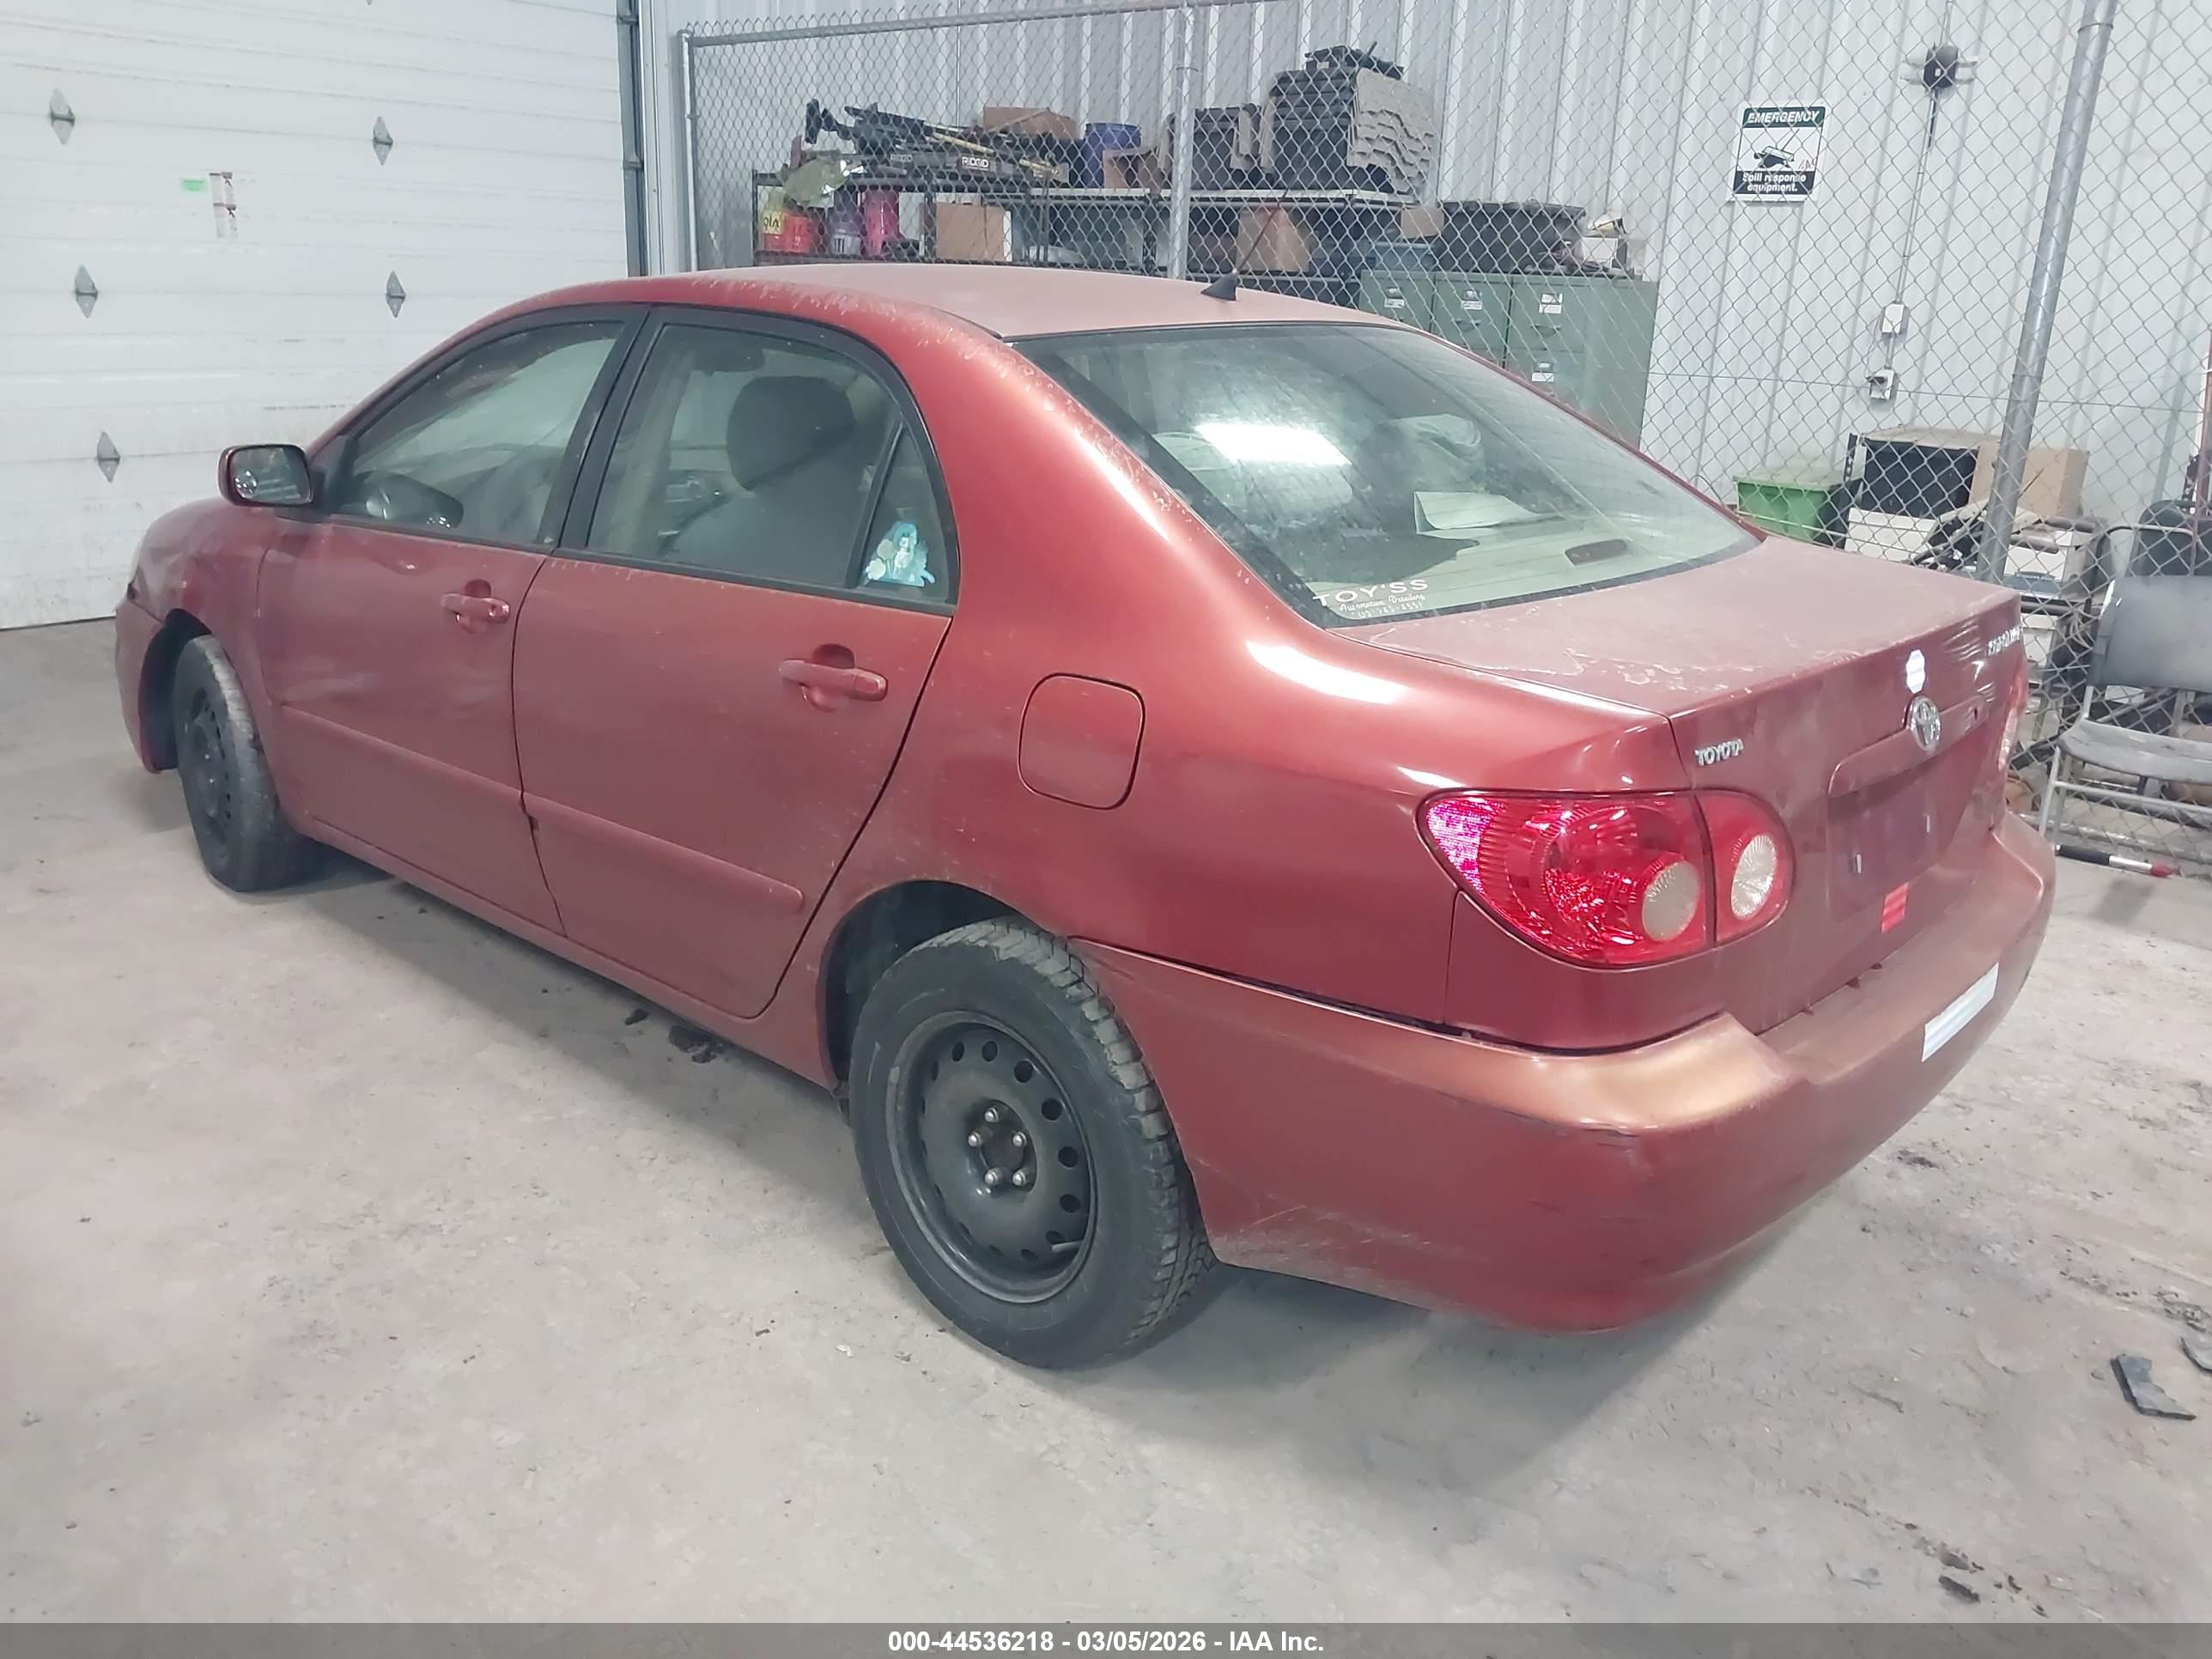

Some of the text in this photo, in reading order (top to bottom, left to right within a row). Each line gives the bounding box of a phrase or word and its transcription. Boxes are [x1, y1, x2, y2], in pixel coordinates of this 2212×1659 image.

[1747, 111, 1820, 124] EMERGENCY
[961, 156, 989, 168] RIDGID
[1742, 172, 1807, 184] Spill rspone
[1312, 579, 1429, 606] TOY'SS
[1694, 738, 1744, 767] TOYOTA
